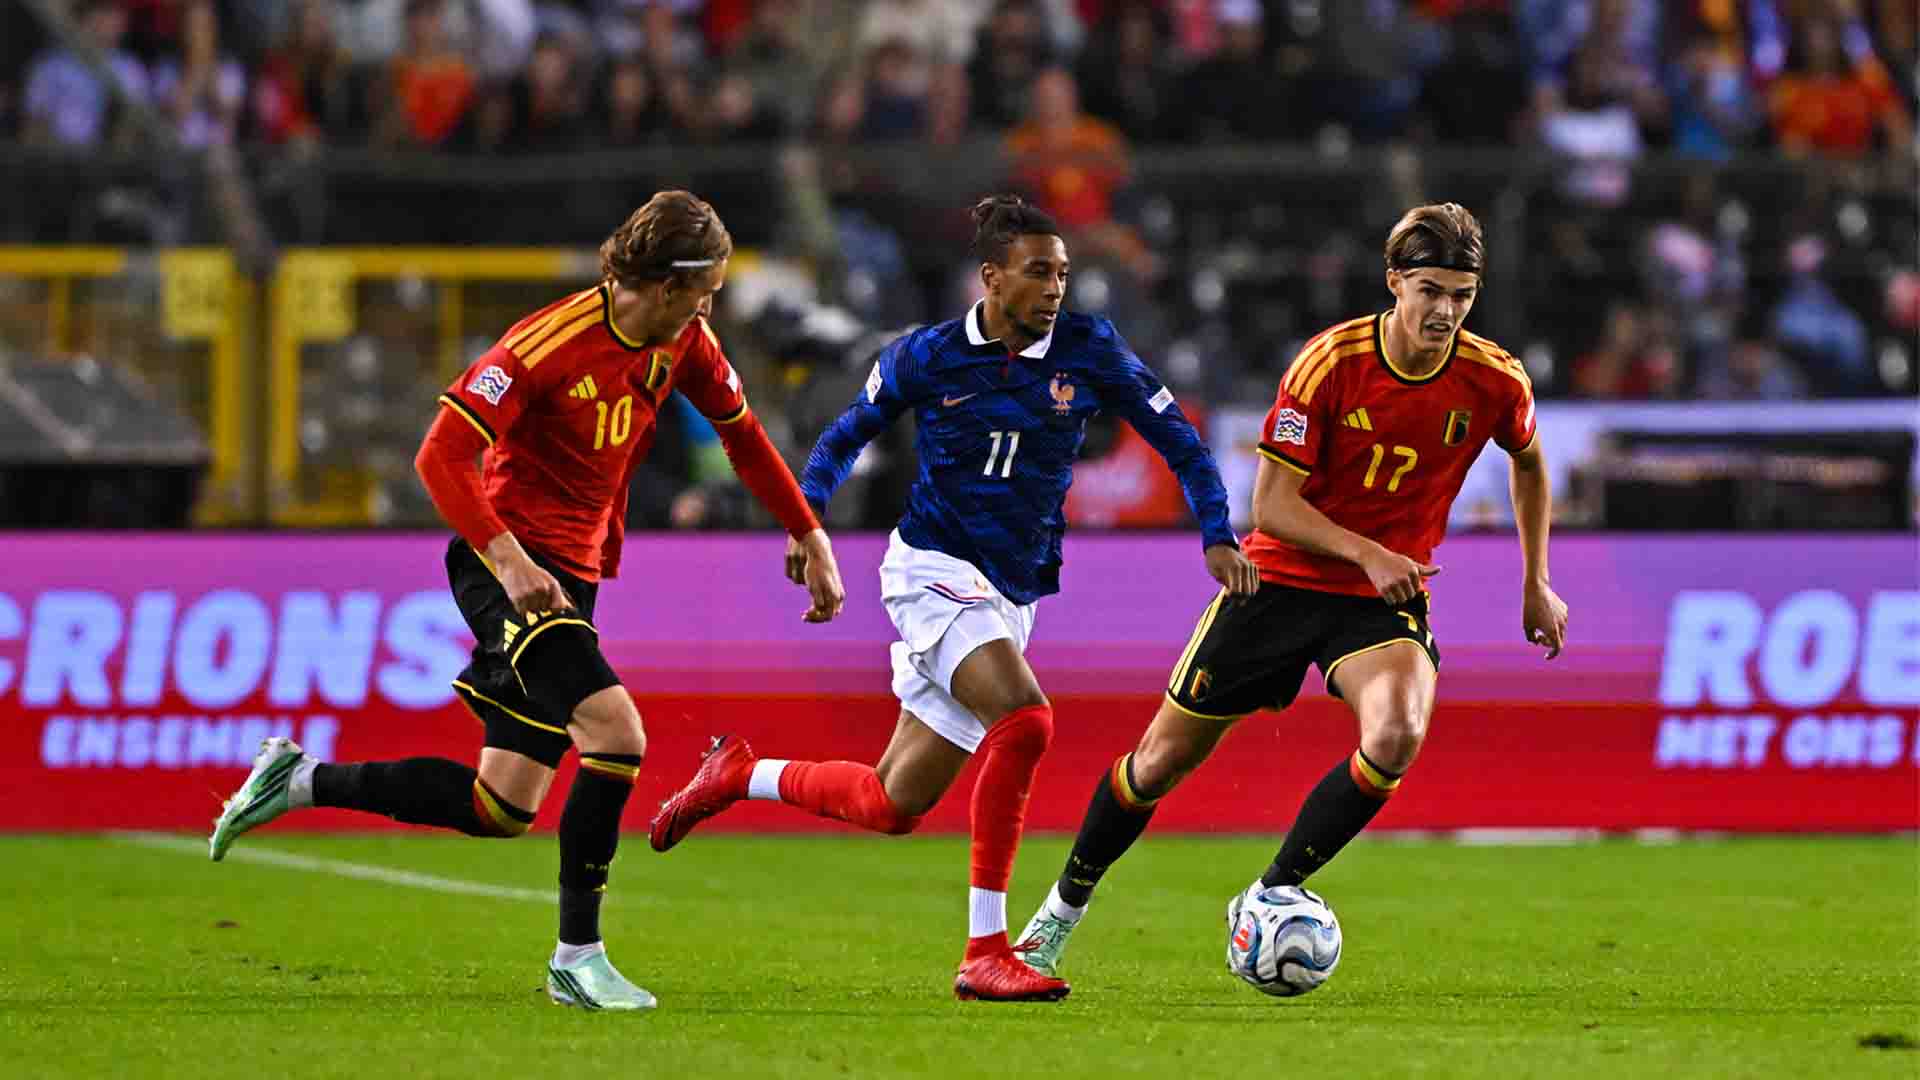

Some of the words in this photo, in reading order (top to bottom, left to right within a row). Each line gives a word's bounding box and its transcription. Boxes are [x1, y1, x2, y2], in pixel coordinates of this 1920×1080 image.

[593, 395, 632, 450] 10
[983, 431, 1020, 478] 11
[1363, 443, 1418, 492] 17
[0, 588, 473, 707] RIONS
[1656, 715, 1776, 767] MET
[1782, 715, 1904, 767] ONS
